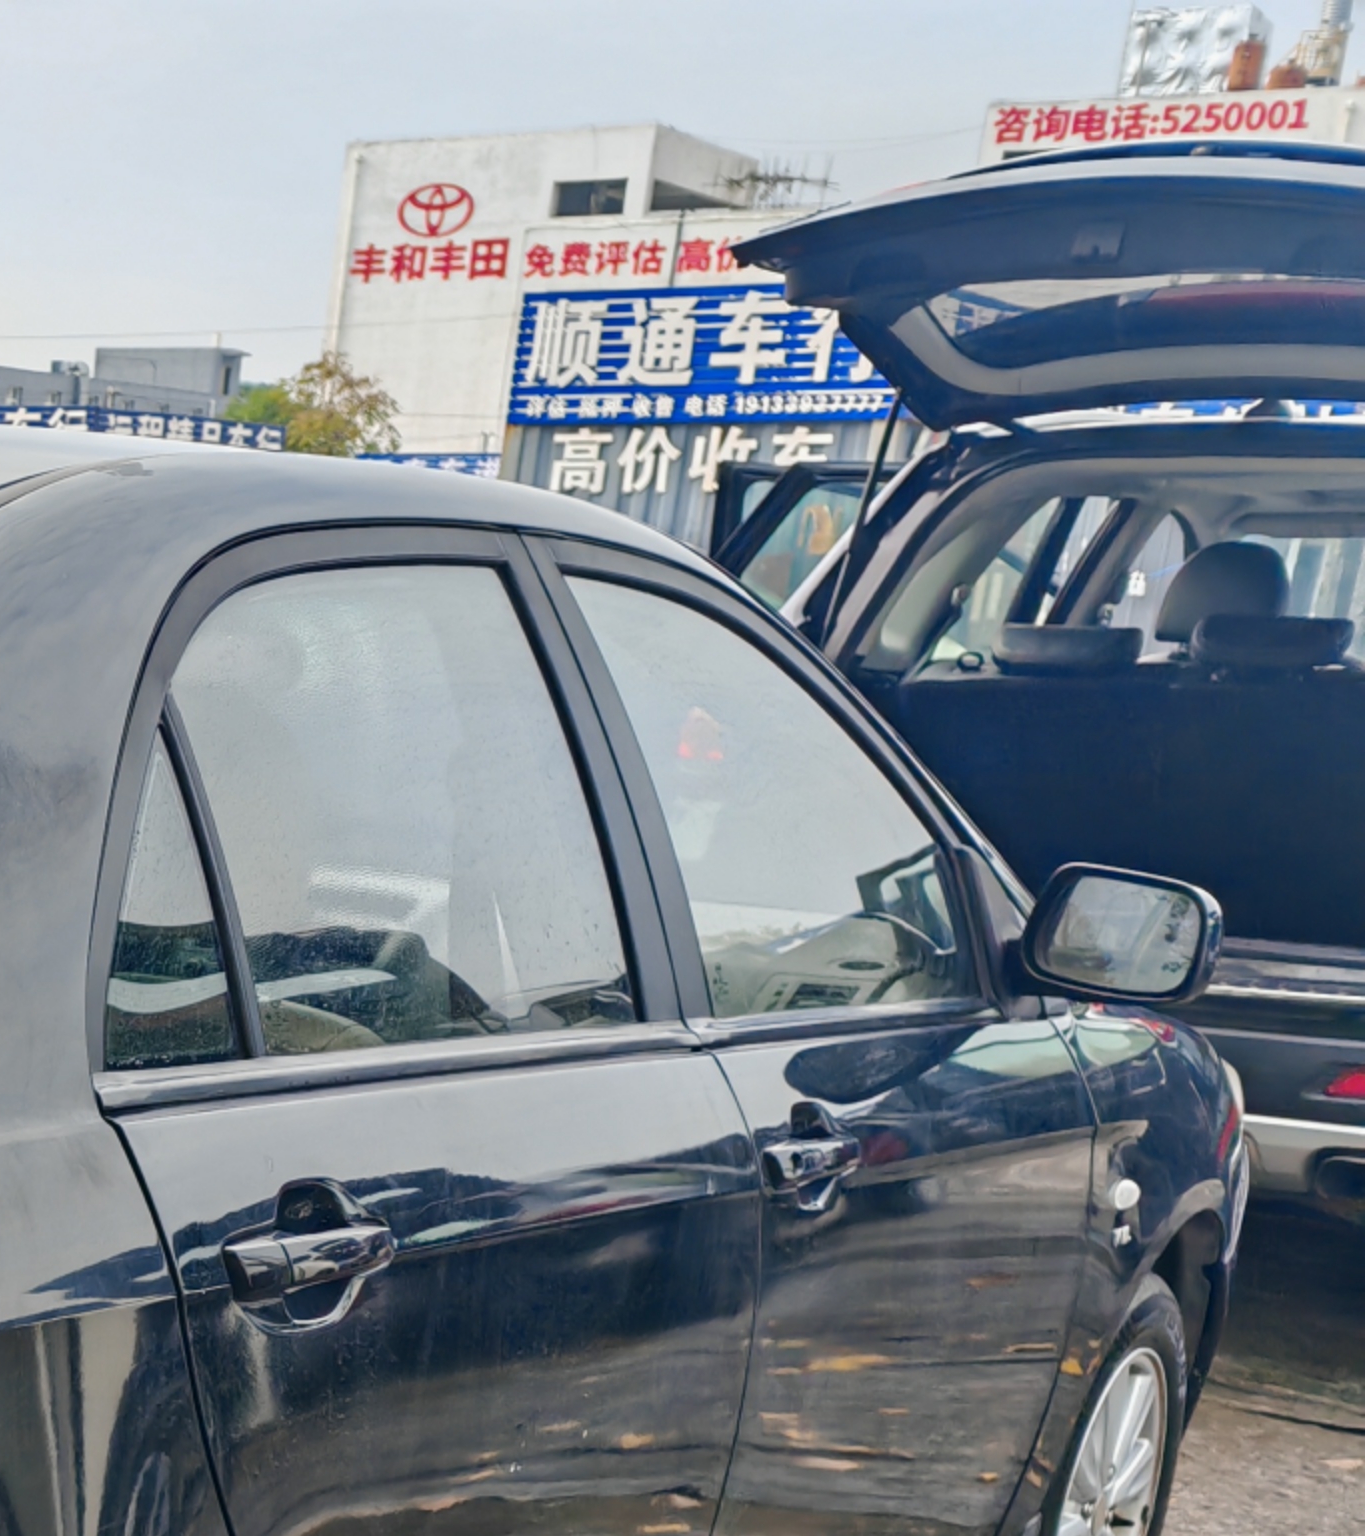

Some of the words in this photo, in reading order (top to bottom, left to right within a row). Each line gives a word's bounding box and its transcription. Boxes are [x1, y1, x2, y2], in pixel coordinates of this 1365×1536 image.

[994, 98, 1309, 145] 咨询电话:5250001
[350, 237, 511, 284] 丰和丰田
[684, 394, 728, 418] 电话
